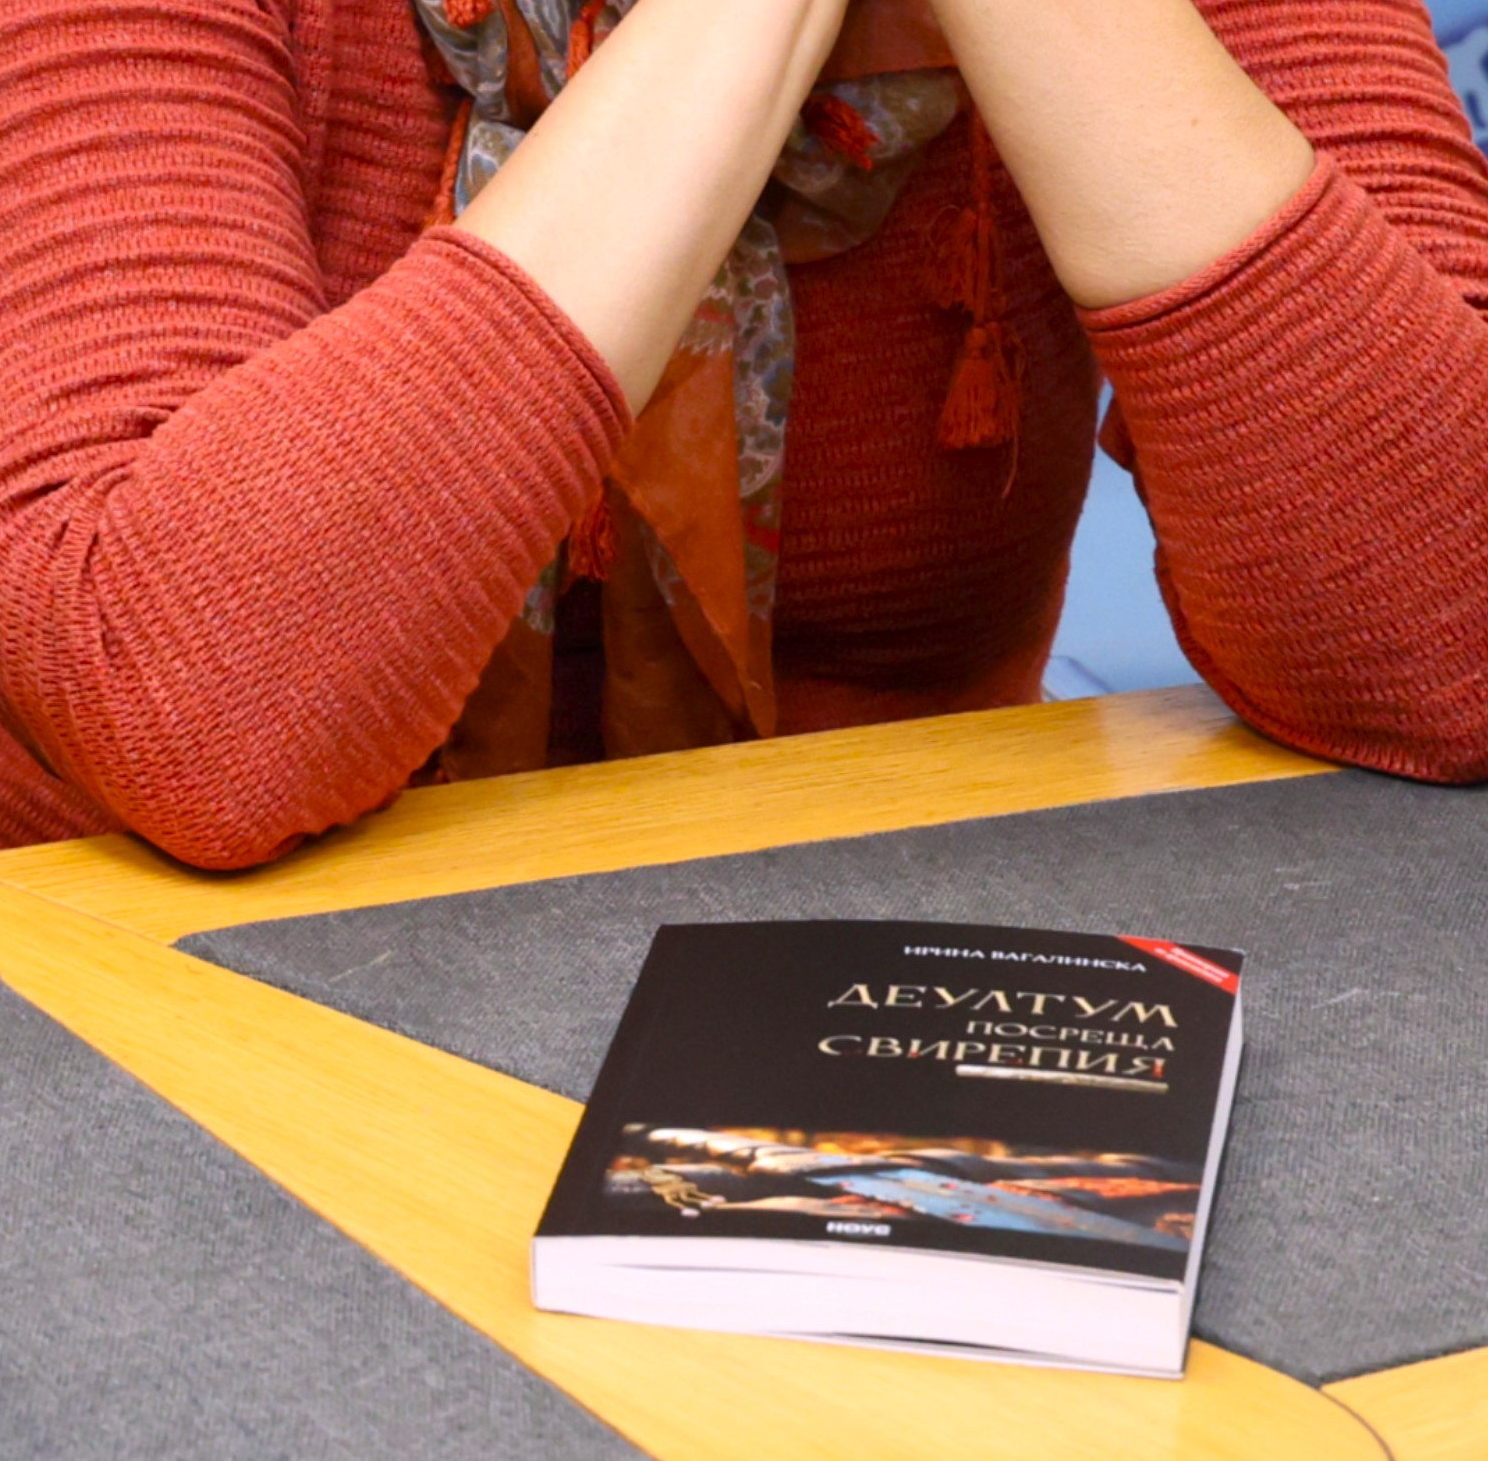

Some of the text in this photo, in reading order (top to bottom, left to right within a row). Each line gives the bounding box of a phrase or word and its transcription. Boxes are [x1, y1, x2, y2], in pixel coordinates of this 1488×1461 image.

[903, 944, 985, 960] ИРИНА
[991, 949, 1147, 973] ВАГАЛИНСКА
[827, 982, 1179, 1028] ДЕУЛТУМ
[966, 1020, 1175, 1051] ПОСРЕЩА
[818, 1034, 1167, 1079] СВИРЕПИЯ
